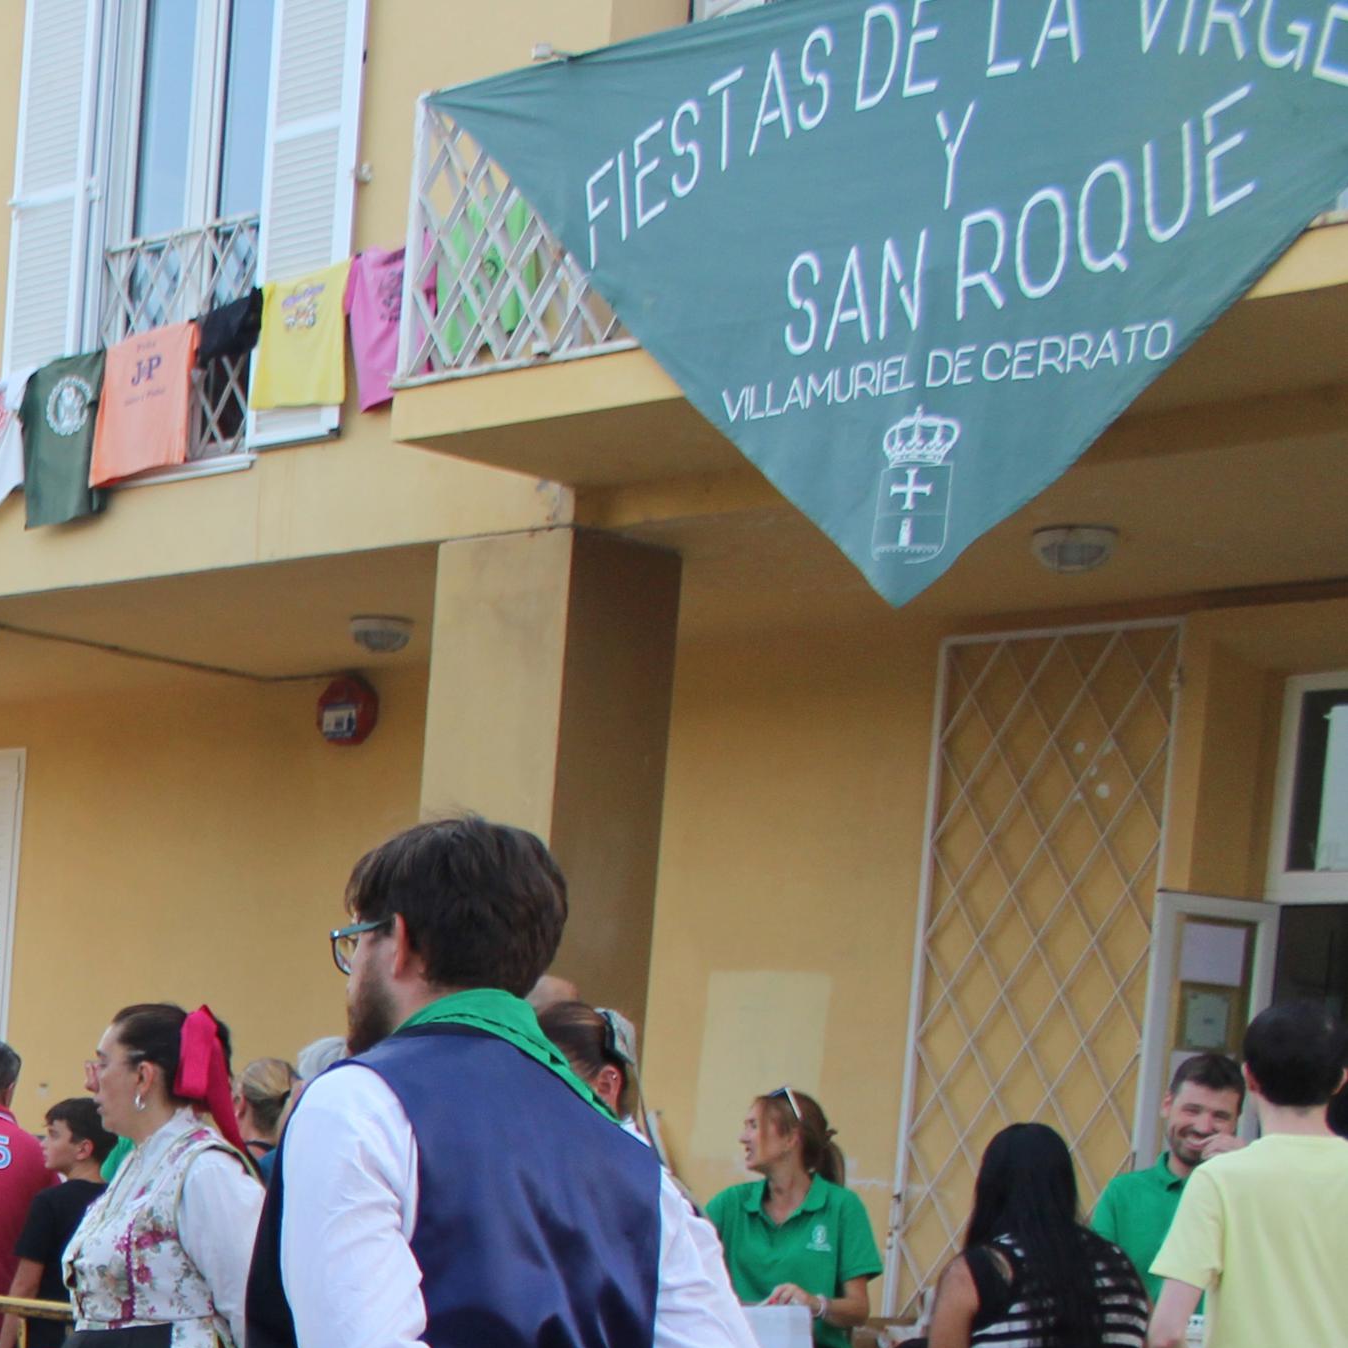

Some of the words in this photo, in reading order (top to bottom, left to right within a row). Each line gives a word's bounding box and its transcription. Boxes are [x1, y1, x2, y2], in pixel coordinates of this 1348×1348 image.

[585, 26, 834, 270] FIESTAS
[855, 0, 939, 111] DE
[985, 0, 1081, 77] LA
[784, 227, 929, 355] SAN
[956, 82, 1257, 321] ROQUE
[935, 100, 975, 210] Y
[721, 353, 916, 423] VILLAMURIEL
[924, 345, 977, 388] DE
[981, 319, 1174, 381] CERRATO
